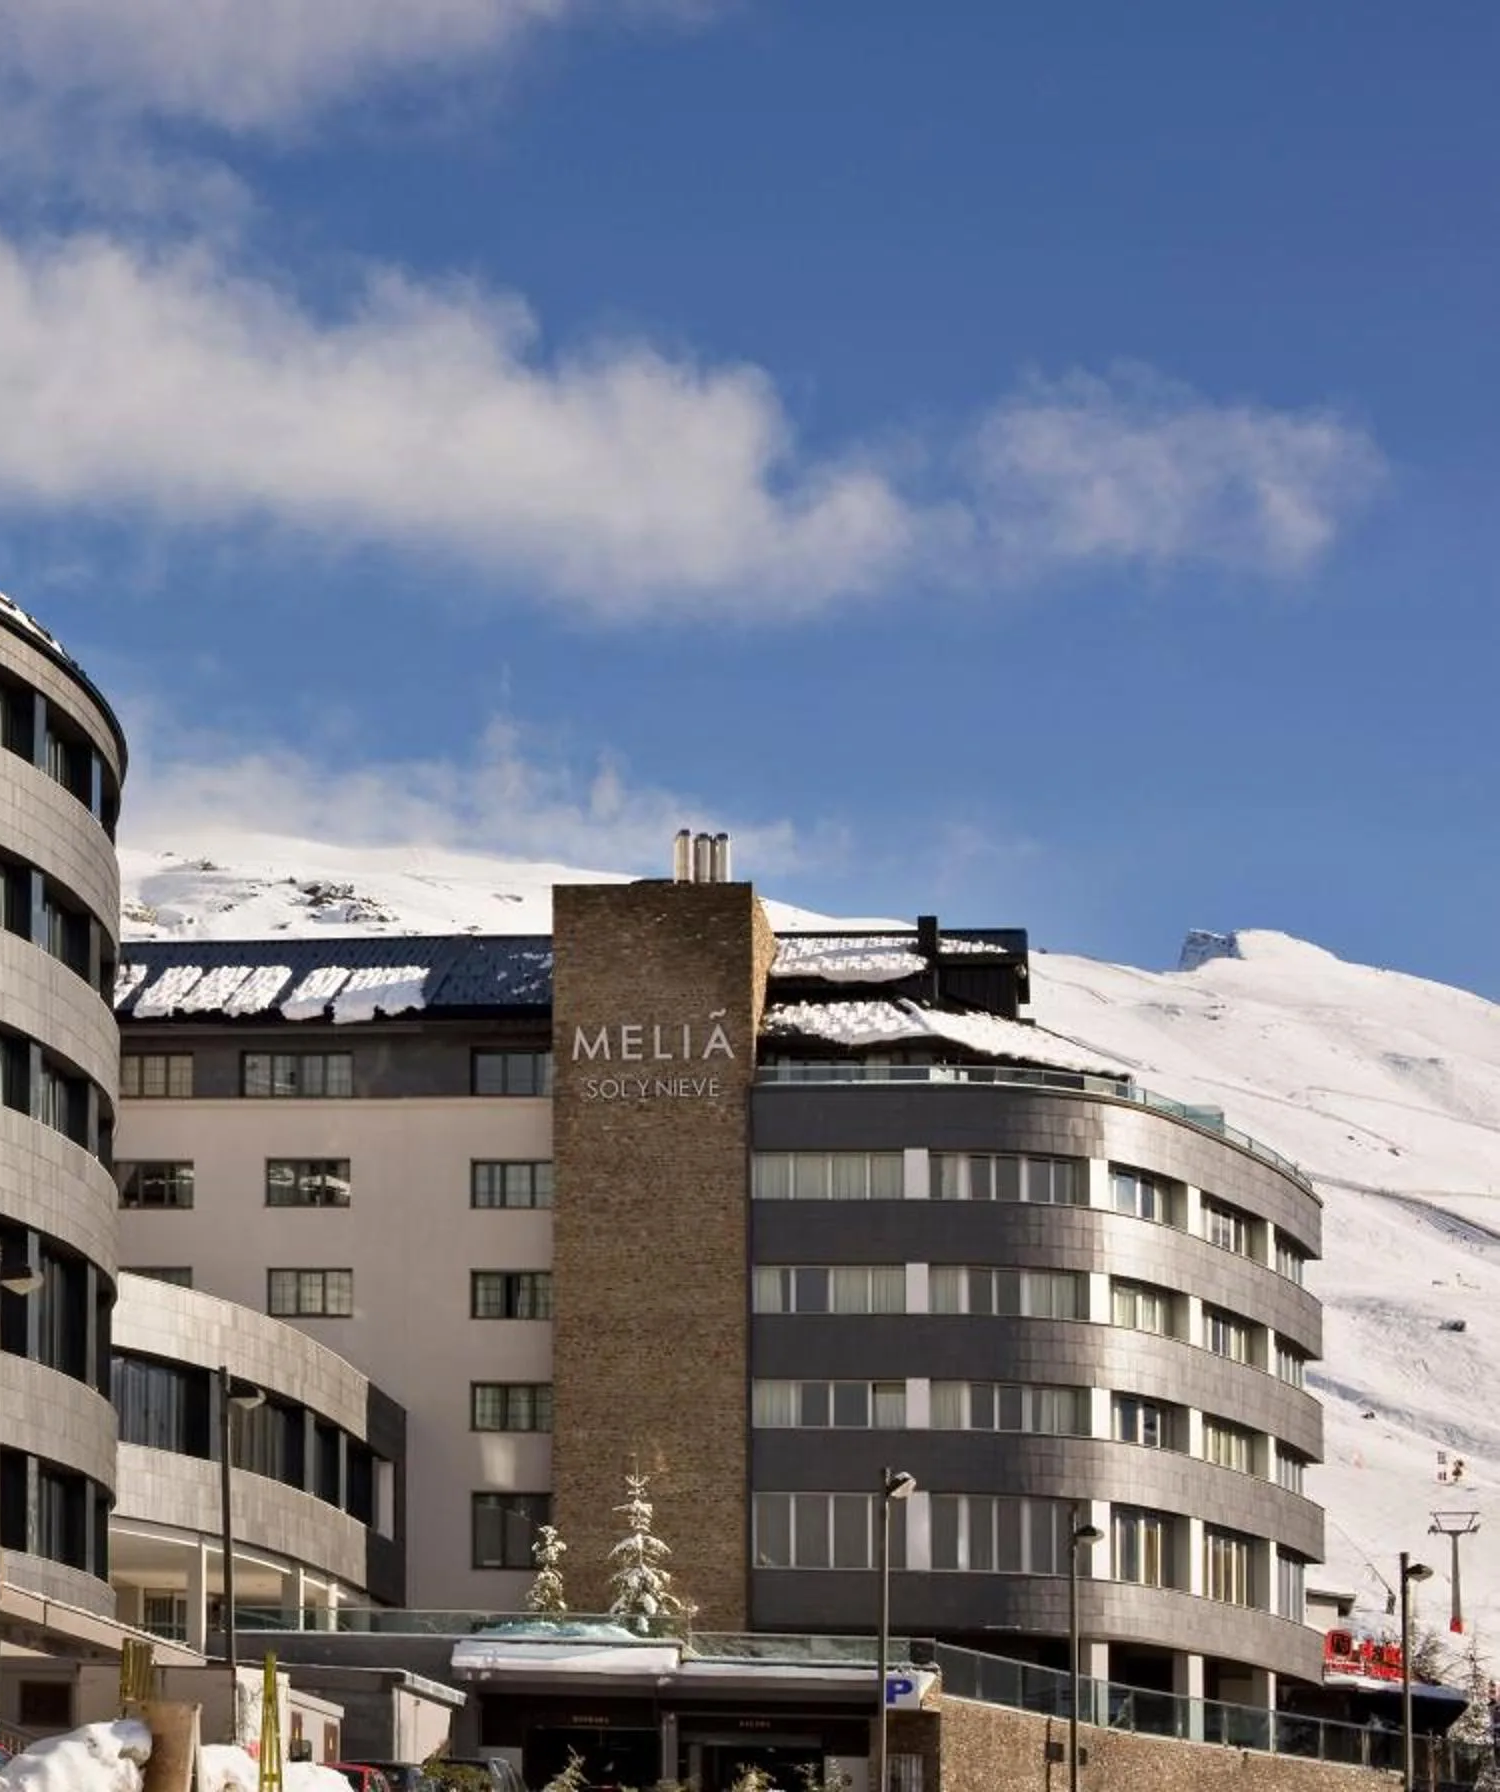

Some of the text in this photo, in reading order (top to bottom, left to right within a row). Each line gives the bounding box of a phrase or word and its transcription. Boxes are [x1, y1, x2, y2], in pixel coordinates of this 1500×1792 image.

[587, 1078, 720, 1099] SOL Y NIEVE
[886, 1679, 913, 1704] P
